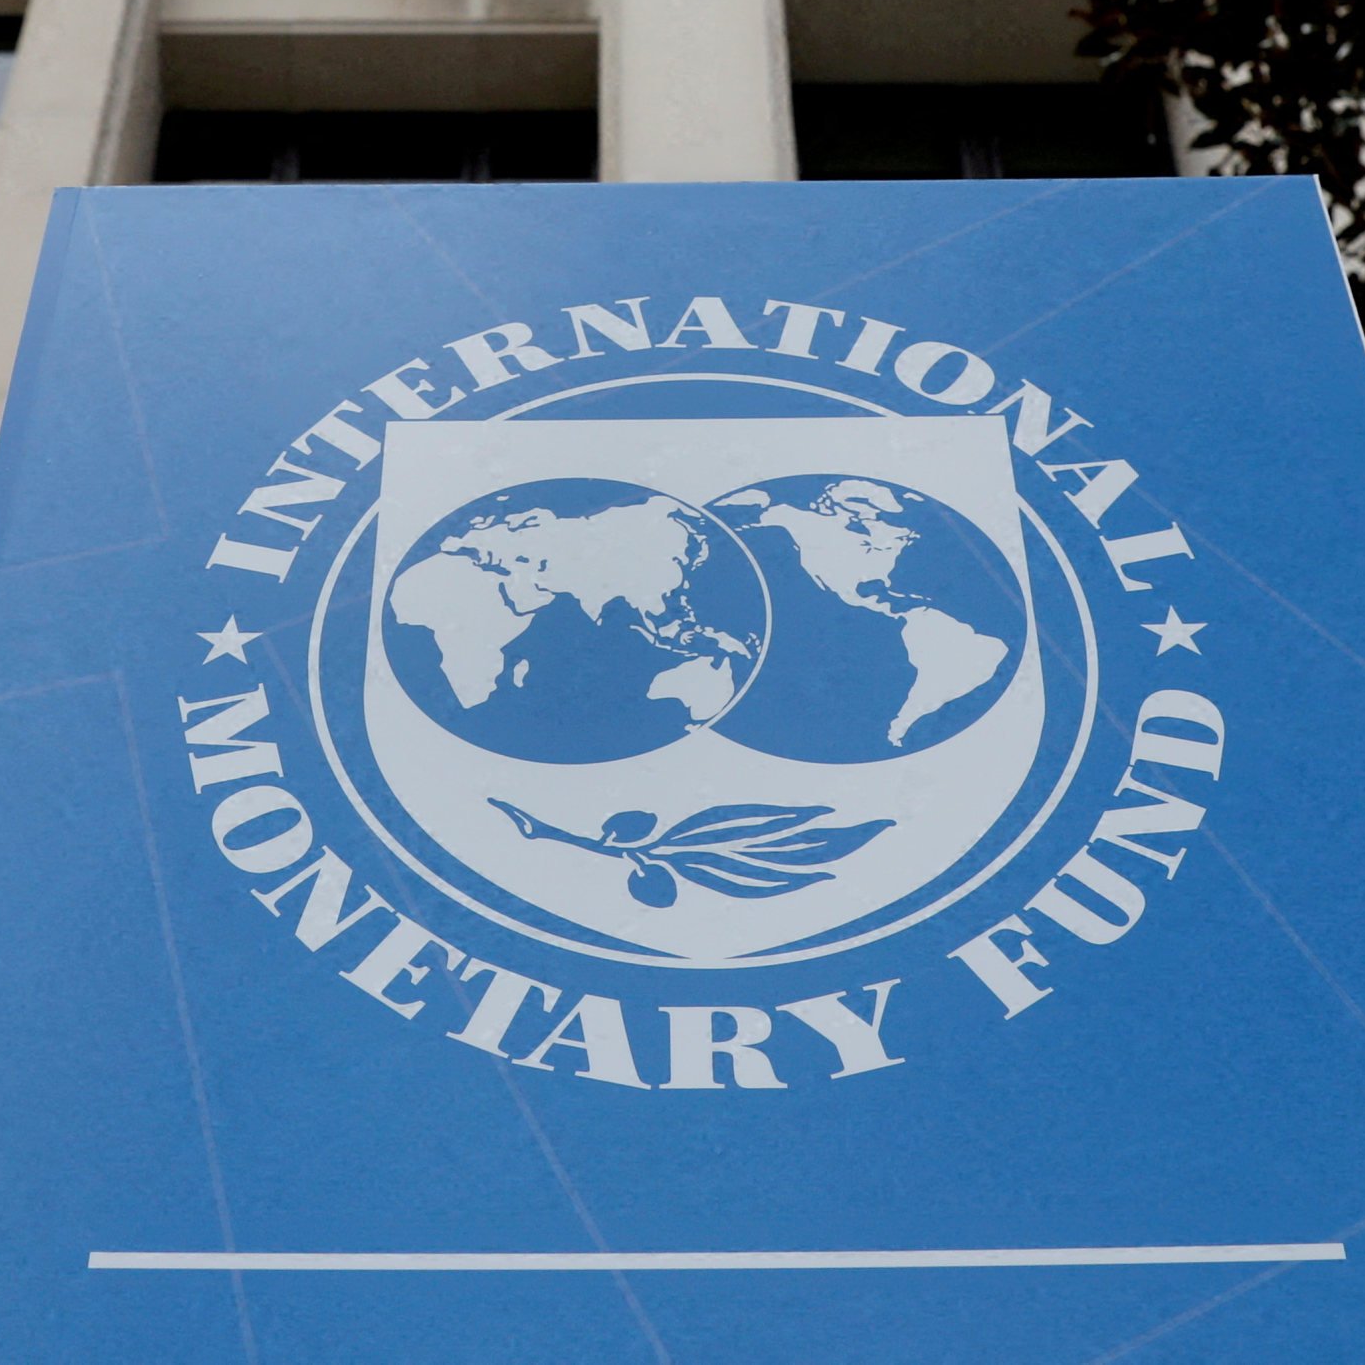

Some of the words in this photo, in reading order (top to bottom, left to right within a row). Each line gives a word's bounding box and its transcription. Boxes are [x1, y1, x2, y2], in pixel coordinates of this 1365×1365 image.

[206, 296, 1195, 592] INTERNATIONAL
[178, 683, 905, 1089] MONETARY
[947, 690, 1225, 1020] FUND
